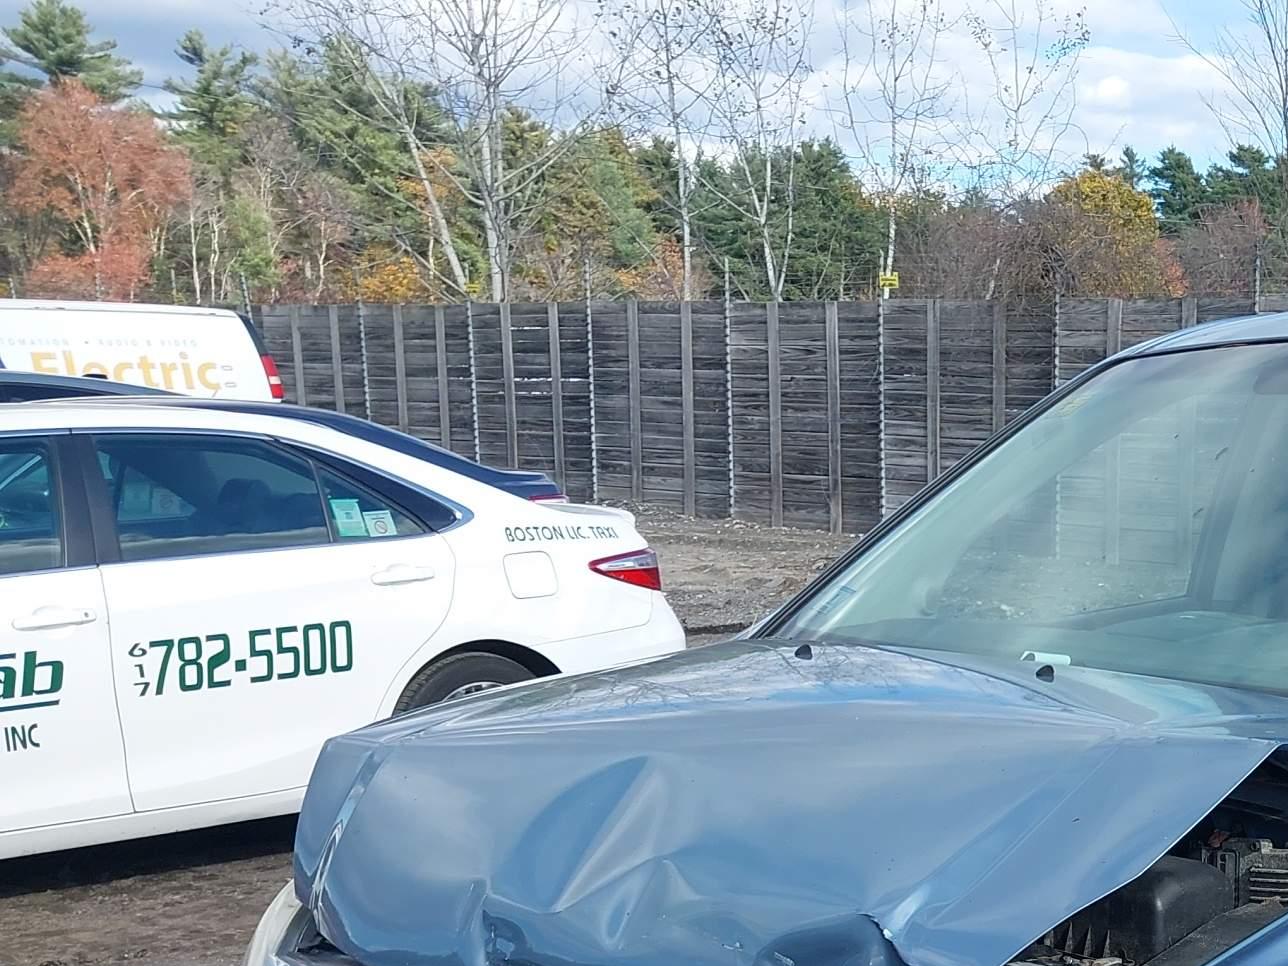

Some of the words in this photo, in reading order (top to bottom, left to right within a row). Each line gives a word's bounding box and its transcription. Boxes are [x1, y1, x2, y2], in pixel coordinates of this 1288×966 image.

[504, 525, 566, 542] BOSTON
[565, 525, 591, 540] LIC.
[588, 526, 620, 539] TAXI
[4, 723, 40, 752] INC
